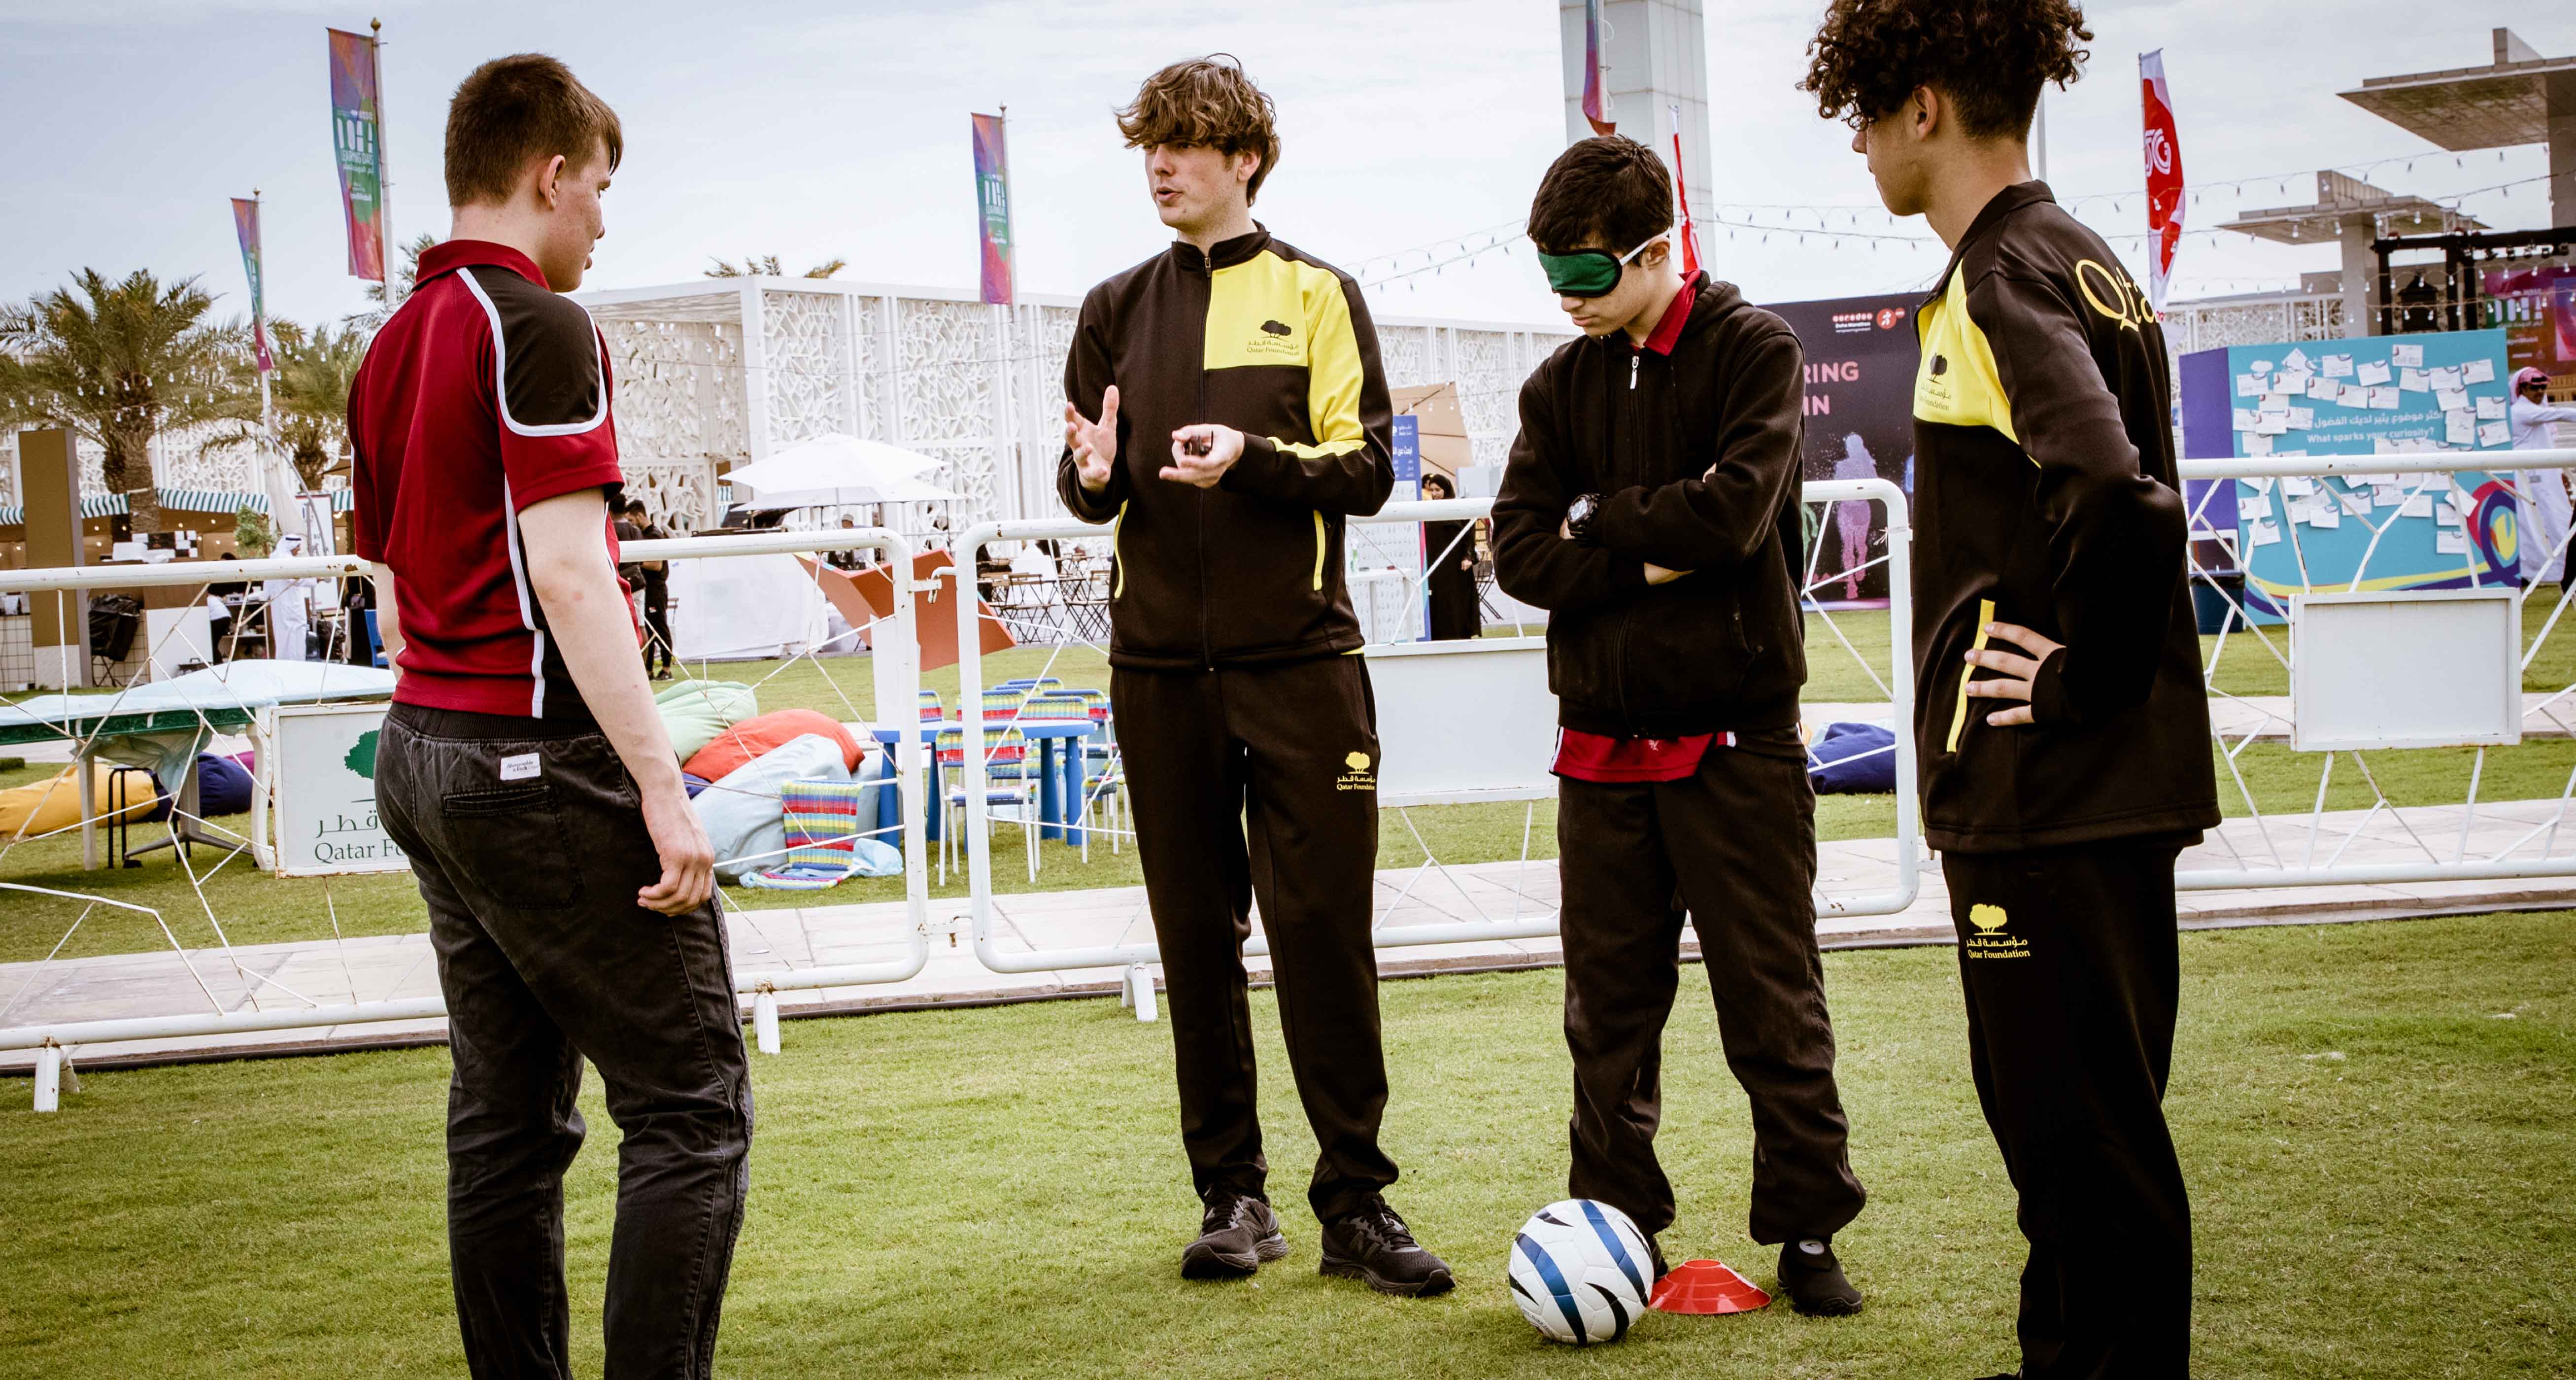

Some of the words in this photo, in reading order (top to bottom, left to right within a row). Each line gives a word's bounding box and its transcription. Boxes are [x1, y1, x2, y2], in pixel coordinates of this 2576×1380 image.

[1832, 313, 1872, 322] ooredoo
[2307, 433, 2332, 443] What
[2333, 432, 2364, 443] sparks
[2367, 431, 2387, 440] your
[2389, 427, 2434, 438] curiosity?
[314, 842, 375, 864] Qatar
[1967, 949, 1983, 959] Qatar
[1984, 949, 2031, 959] Foundation
